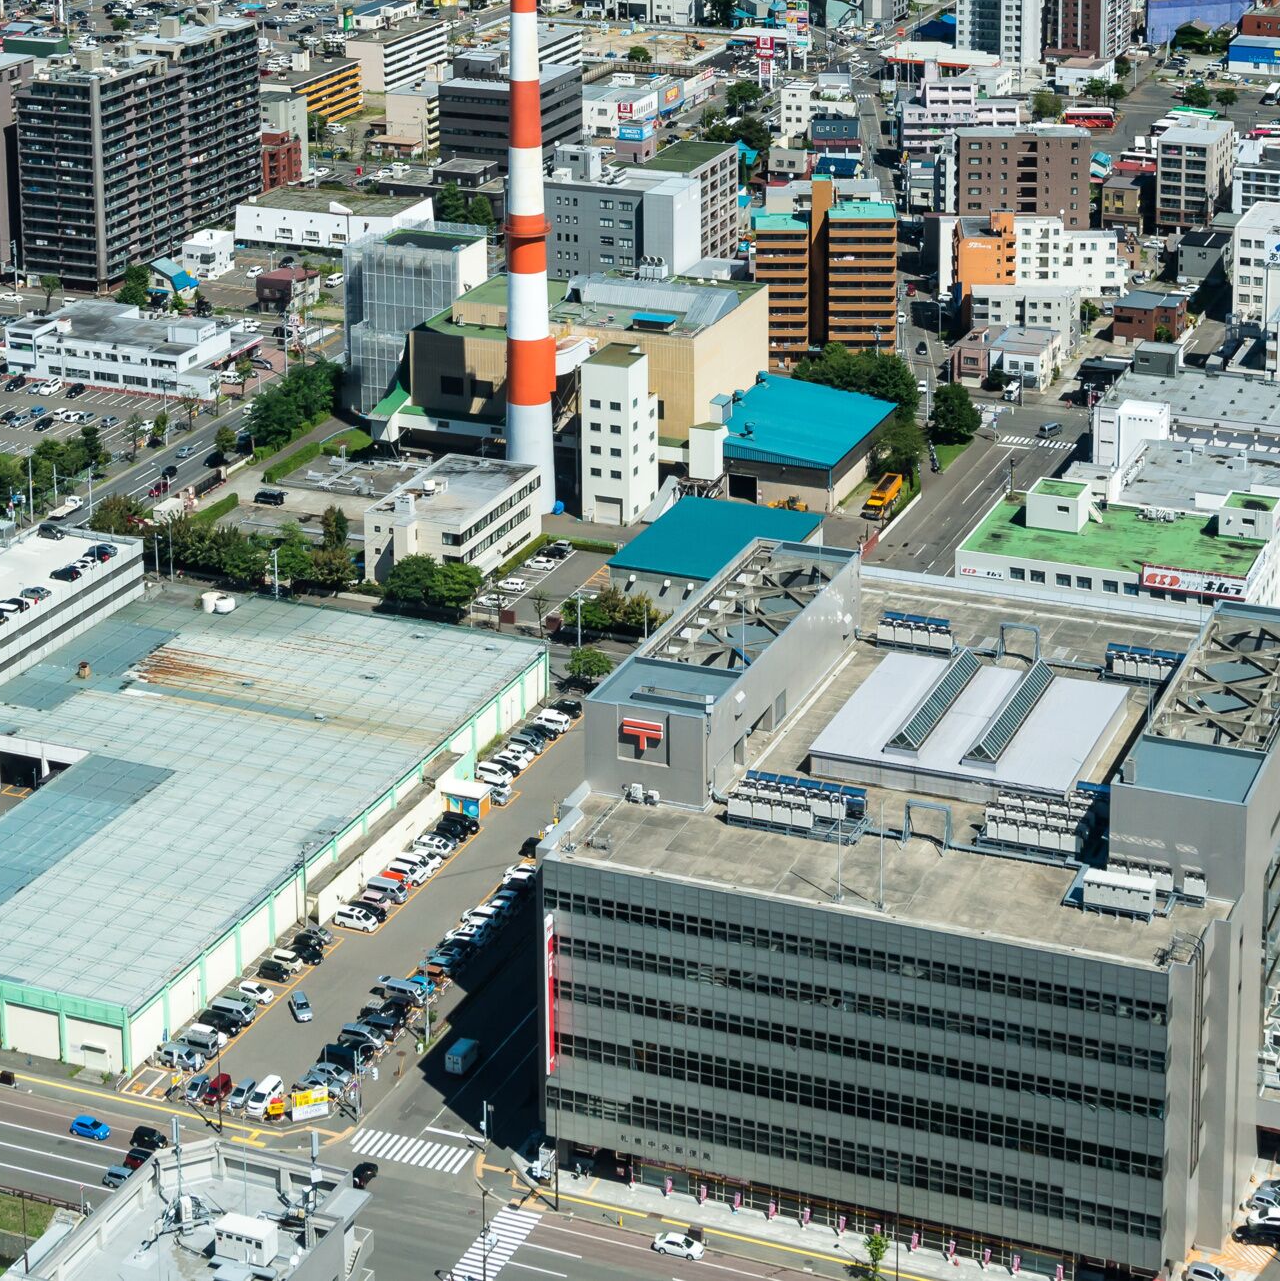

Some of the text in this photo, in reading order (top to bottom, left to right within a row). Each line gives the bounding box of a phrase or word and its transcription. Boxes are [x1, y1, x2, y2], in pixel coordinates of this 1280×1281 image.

[1203, 580, 1244, 596] キムラ
[620, 1134, 712, 1162] 札幌中央郵便局
